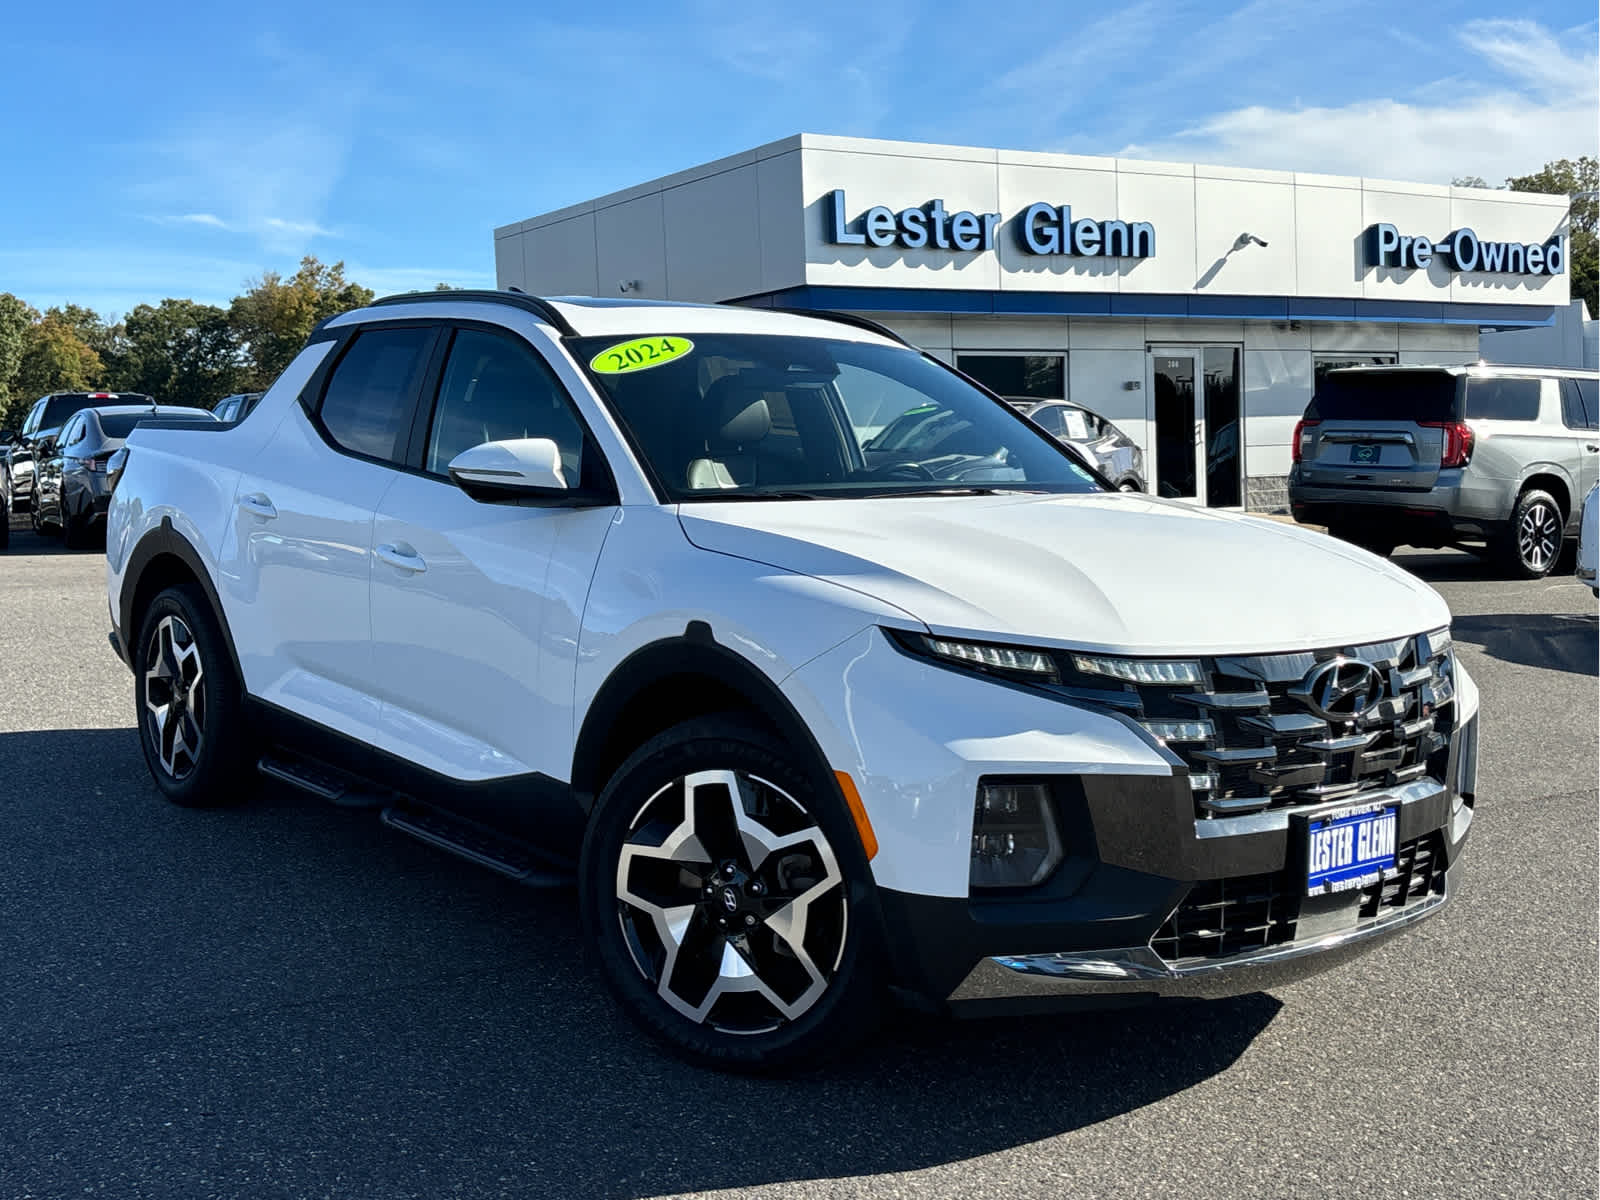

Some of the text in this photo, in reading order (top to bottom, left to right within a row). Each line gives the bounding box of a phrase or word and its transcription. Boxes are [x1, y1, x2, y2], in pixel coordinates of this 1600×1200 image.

[831, 189, 1156, 258] Lester Glenn
[1372, 223, 1565, 275] Pre-Owned
[608, 338, 675, 370] 2024
[1309, 816, 1395, 873] LESTER GLENN
